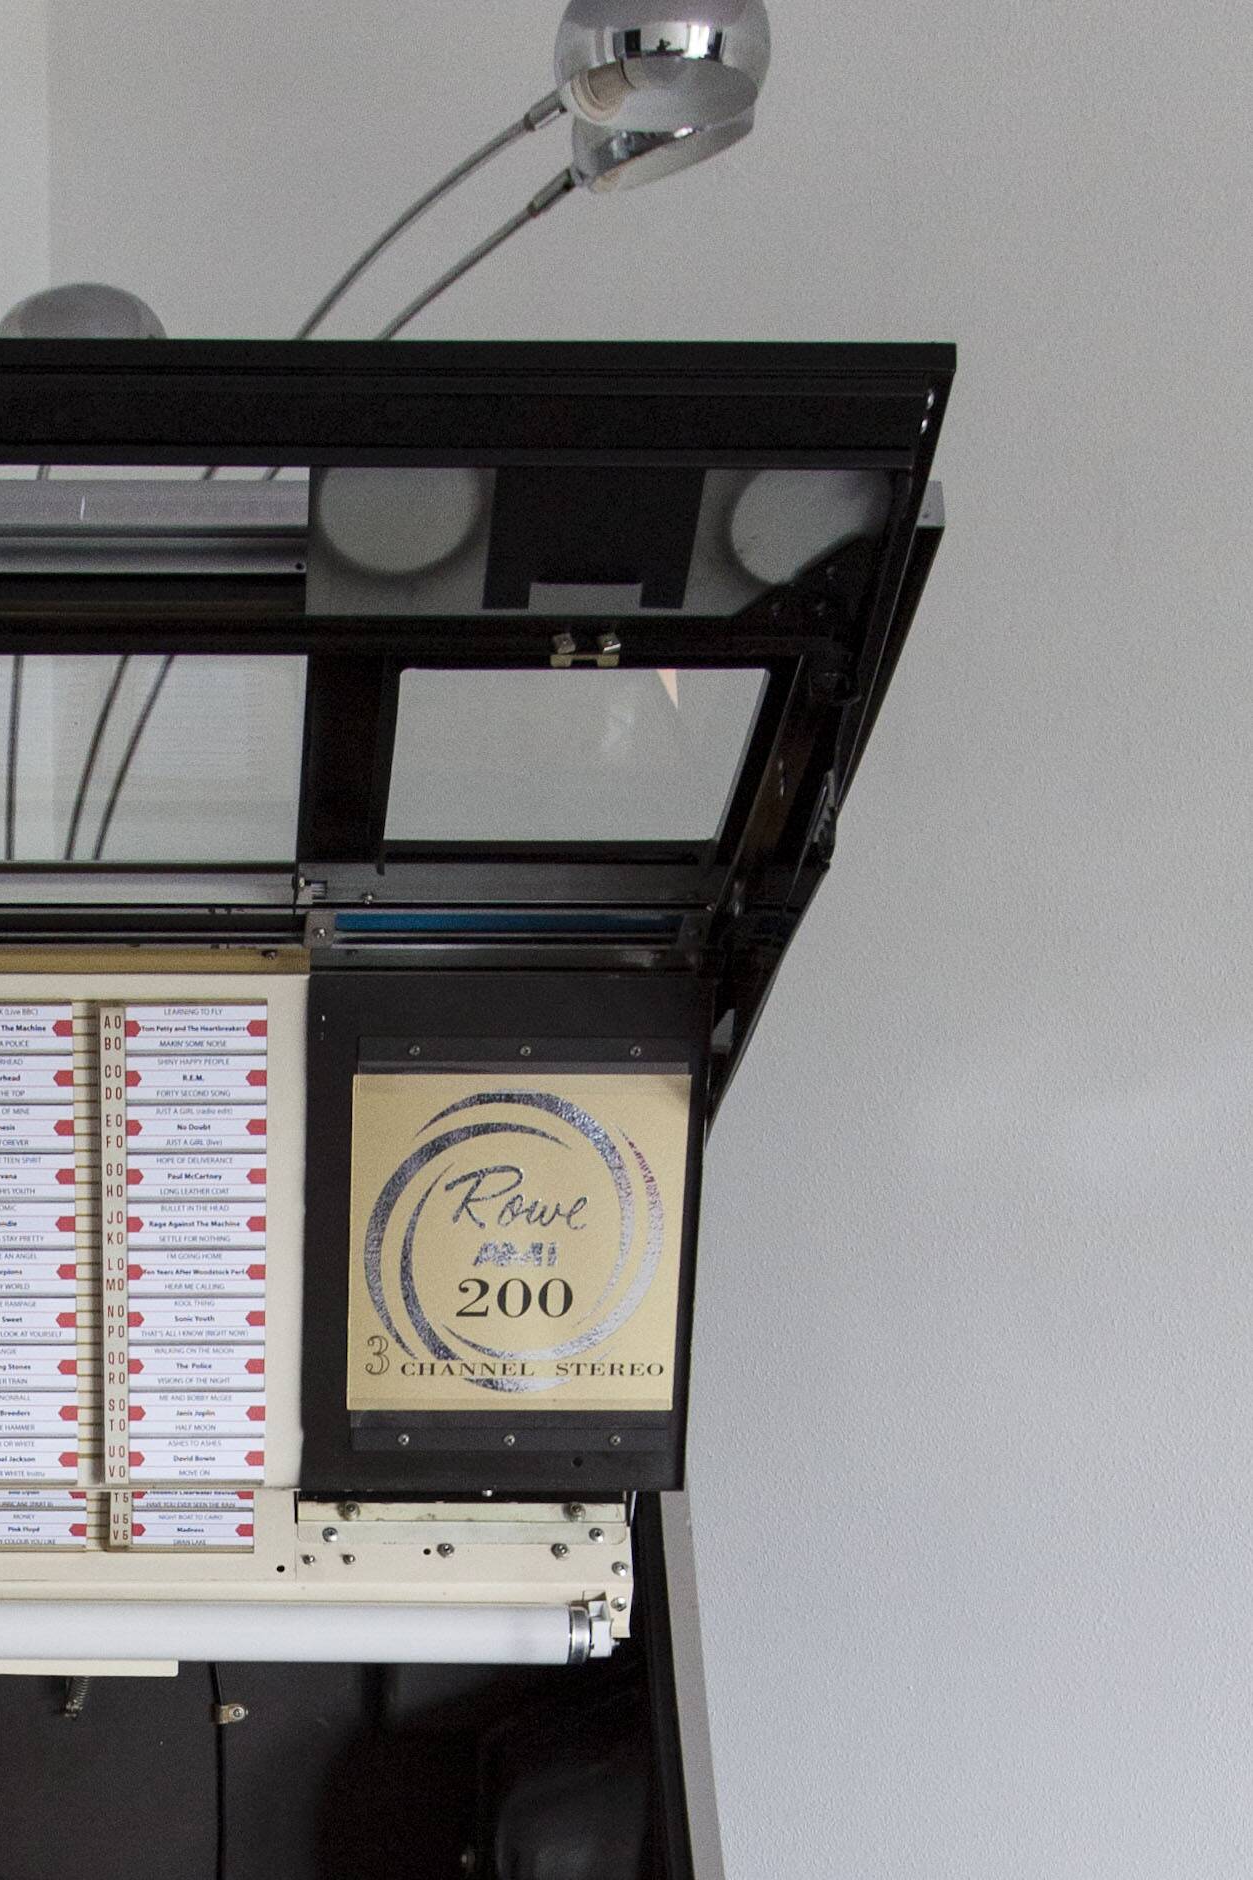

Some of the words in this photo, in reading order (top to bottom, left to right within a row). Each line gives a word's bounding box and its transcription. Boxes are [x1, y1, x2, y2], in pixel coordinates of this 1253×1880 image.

[184, 1173, 223, 1181] McCartney
[444, 1164, 589, 1230] Rowe
[149, 1220, 167, 1228] Rage
[168, 1220, 195, 1228] Against
[473, 1240, 558, 1267] AMI
[455, 1278, 574, 1318] 200
[174, 1315, 193, 1323] Sonic
[194, 1315, 215, 1323] Youth
[364, 1334, 391, 1376] 3
[401, 1361, 535, 1377] CHANNEL
[556, 1361, 665, 1377] STEREO
